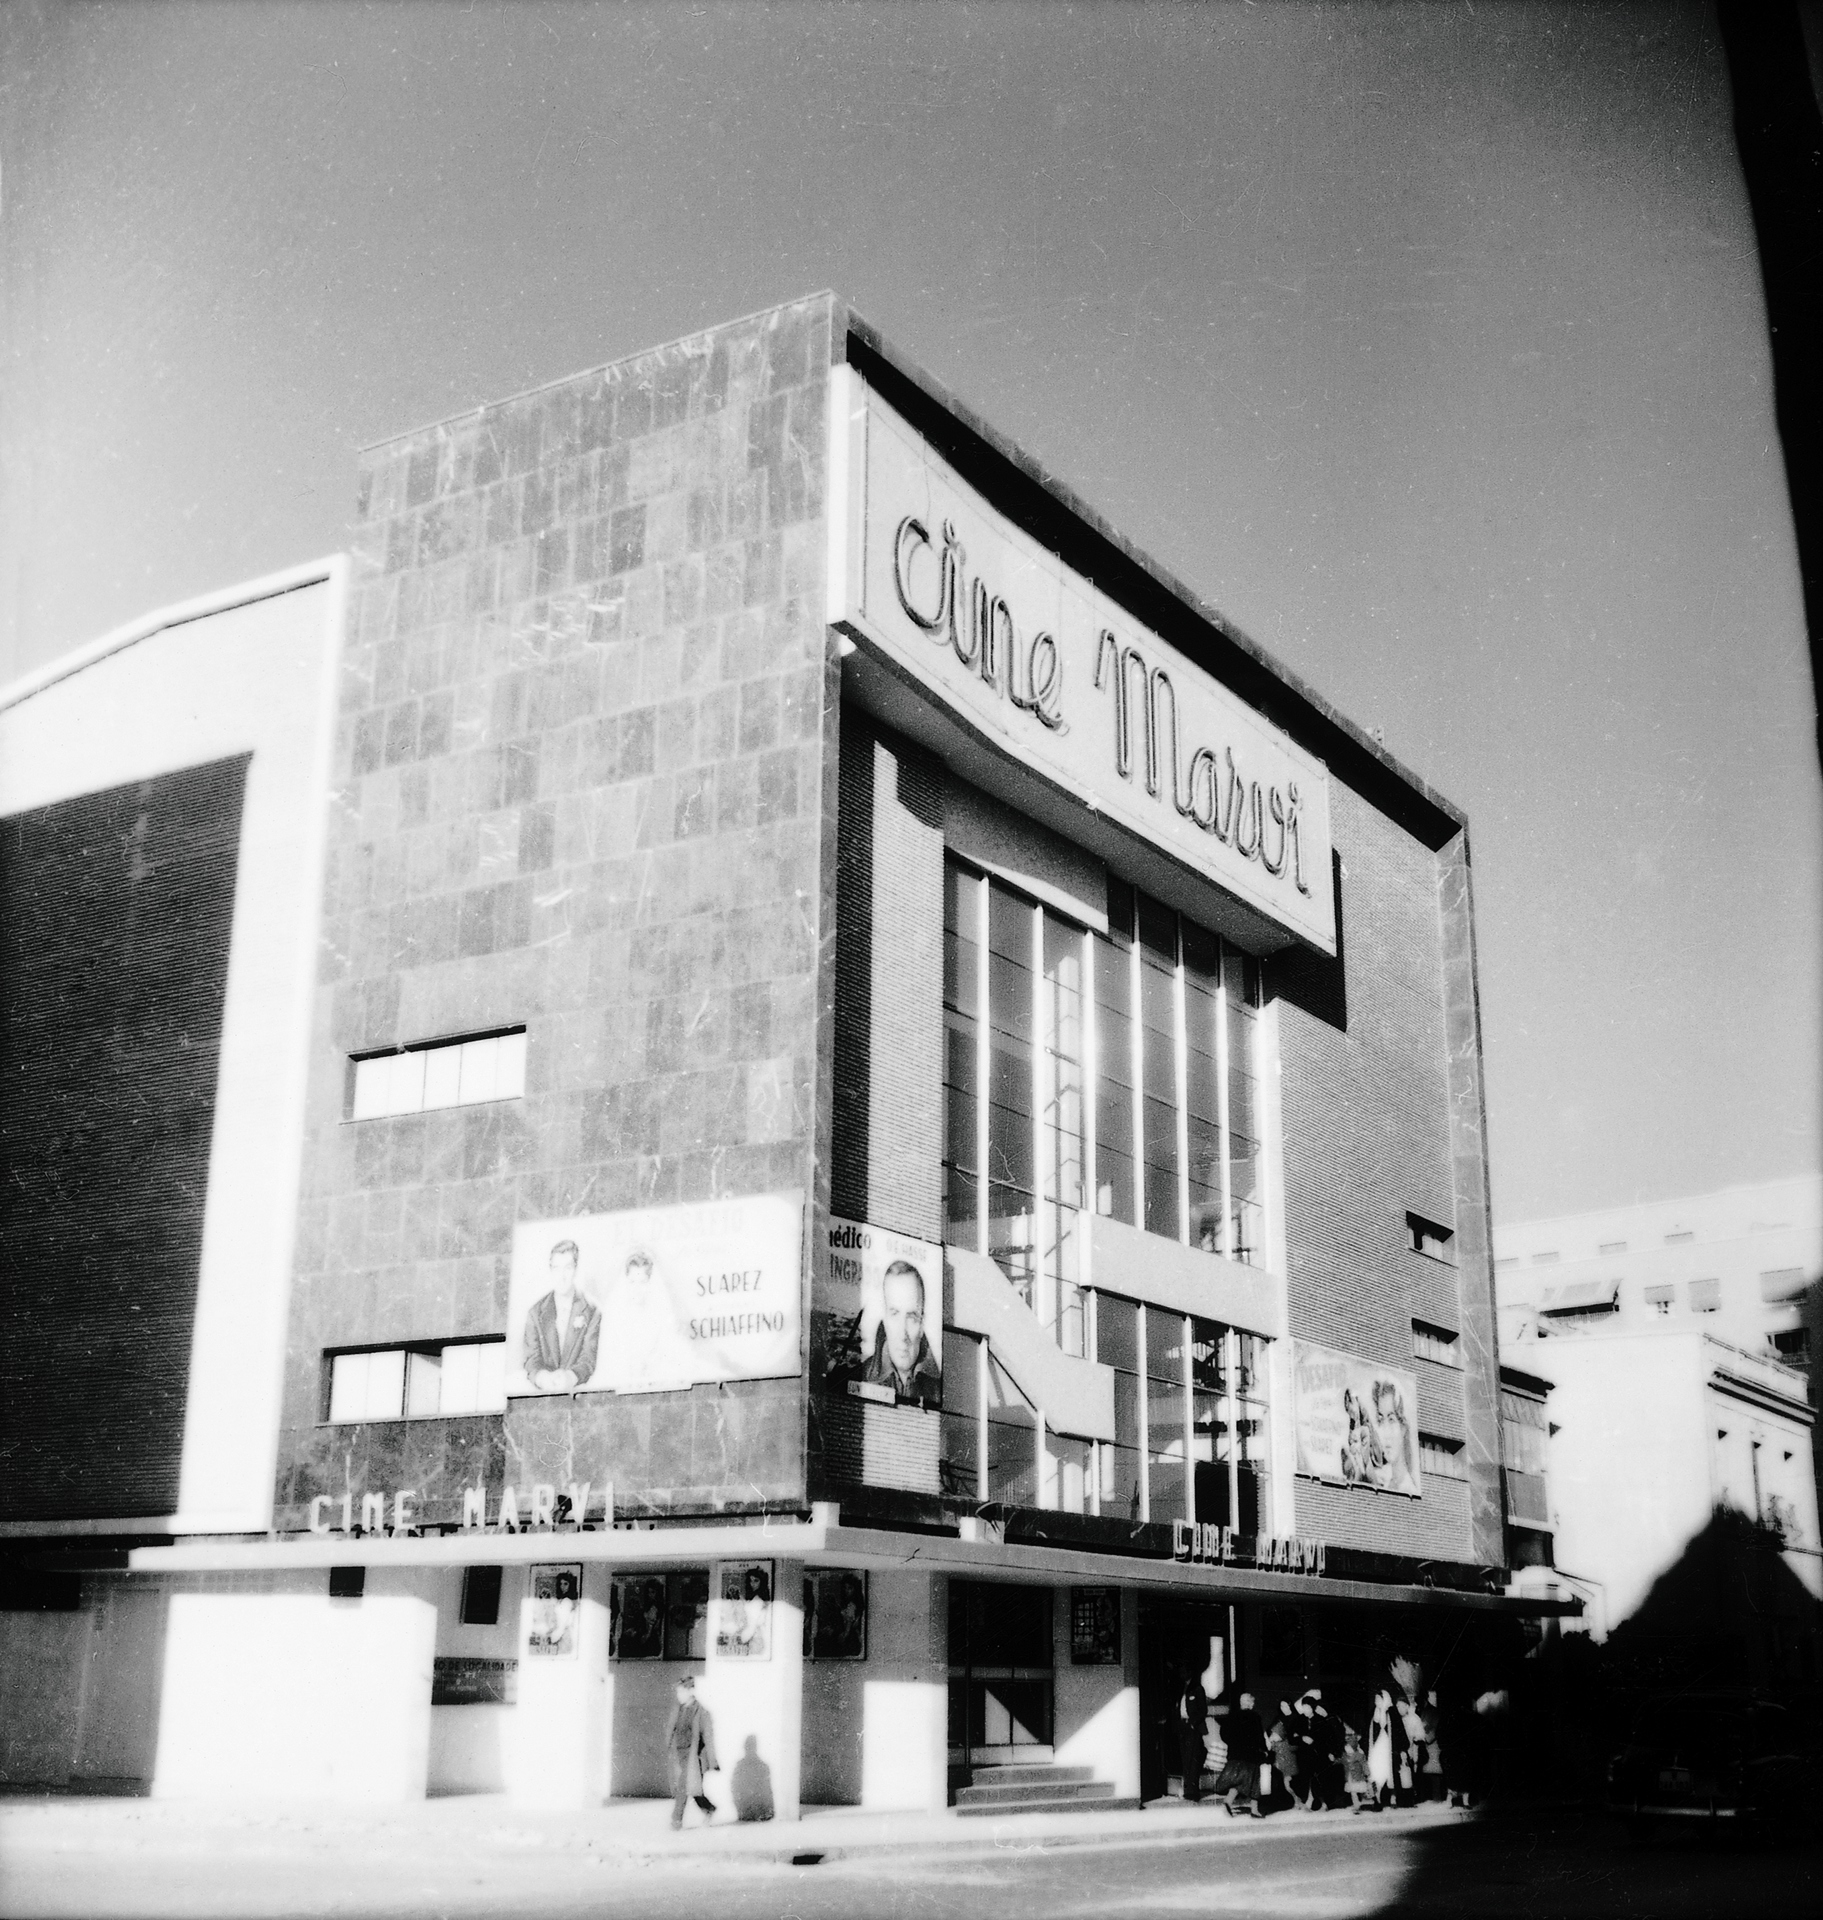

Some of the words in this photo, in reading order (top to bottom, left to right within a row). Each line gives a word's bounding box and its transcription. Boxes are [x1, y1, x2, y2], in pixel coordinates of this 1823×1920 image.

[893, 515, 1066, 732] Cine
[1093, 628, 1313, 897] Marvi
[696, 1269, 763, 1297] SUAREZ
[689, 1310, 785, 1340] SCHIAFFINO
[309, 1490, 416, 1535] CINE
[463, 1480, 615, 1530] MARVI
[1173, 1520, 1236, 1566] CINE
[1256, 1538, 1326, 1576] MARVI
